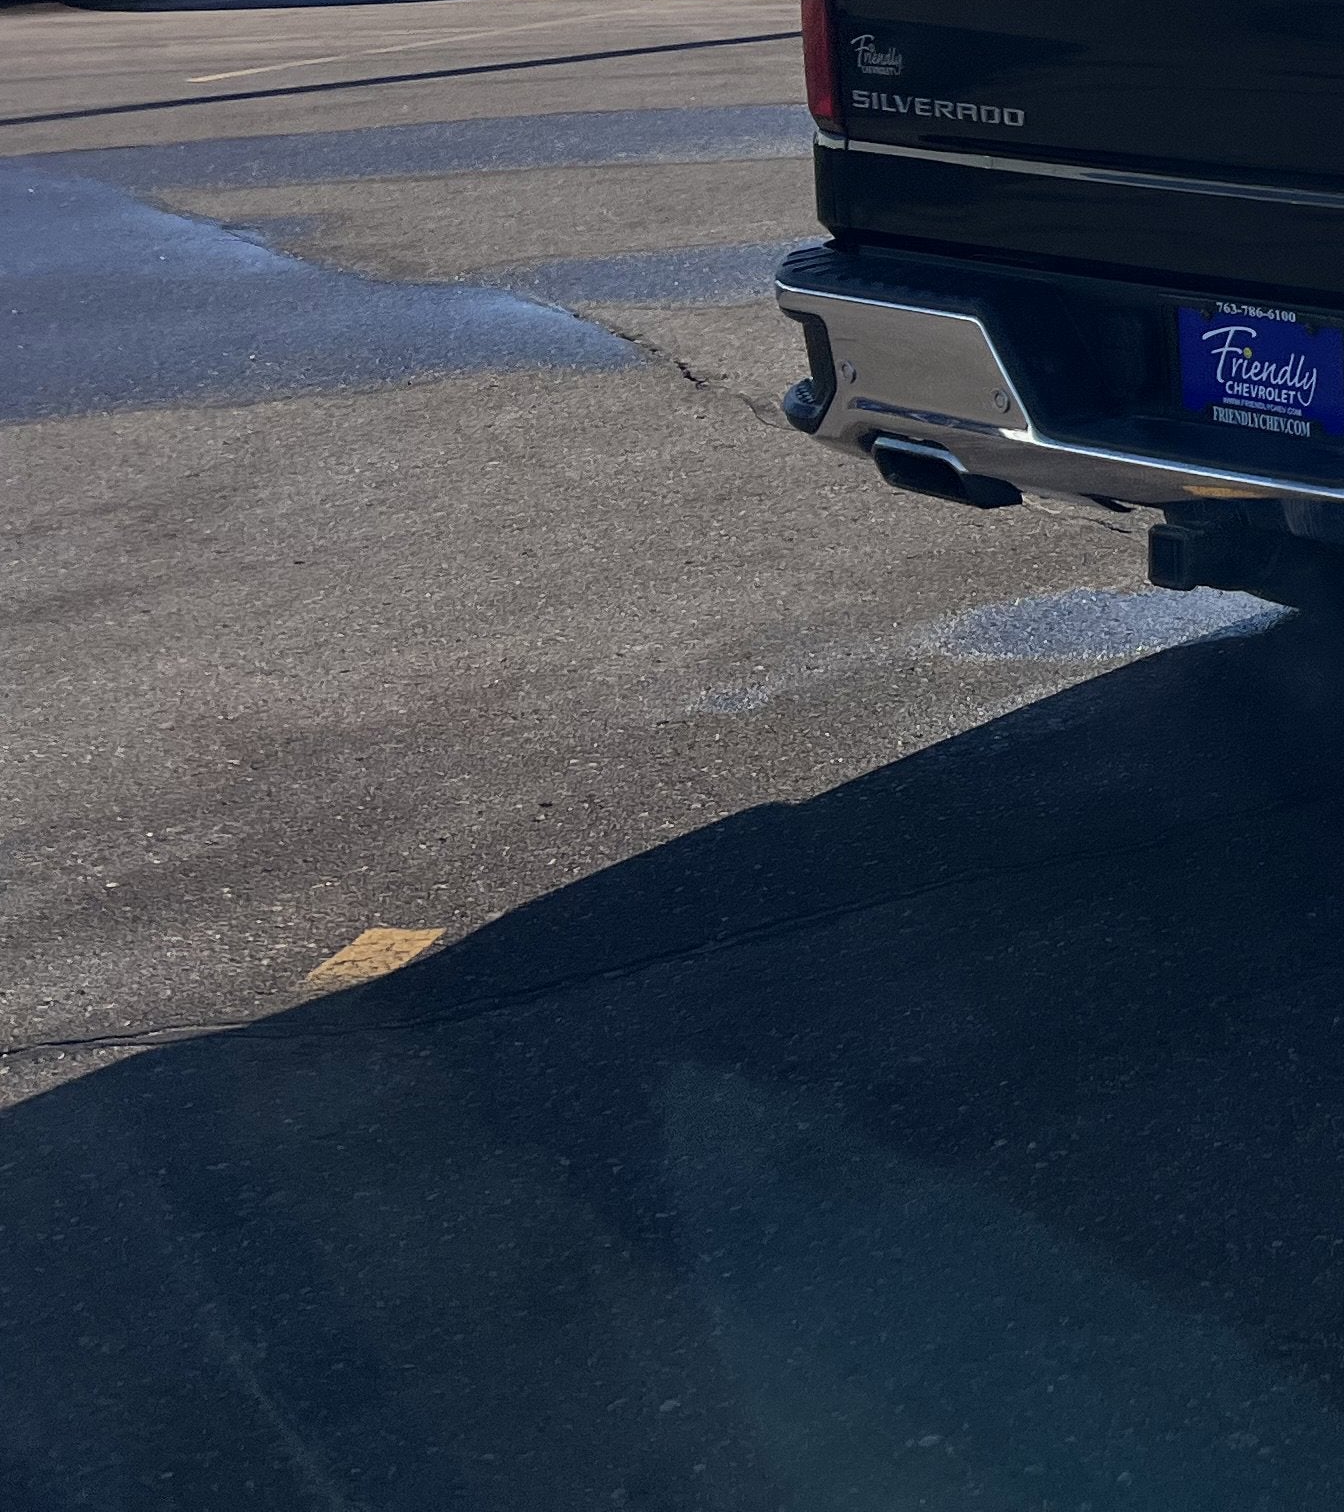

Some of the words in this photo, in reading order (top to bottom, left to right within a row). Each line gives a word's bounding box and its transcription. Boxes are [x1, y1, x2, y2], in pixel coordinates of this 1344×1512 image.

[850, 34, 902, 75] Friendly
[852, 89, 1025, 127] SILVERADO
[1216, 302, 1297, 323] 763-786-6100
[1202, 325, 1318, 406] Friendly
[1225, 380, 1296, 405] CHEVROLET
[1212, 406, 1311, 437] FRIENDLYCHEV.COM
